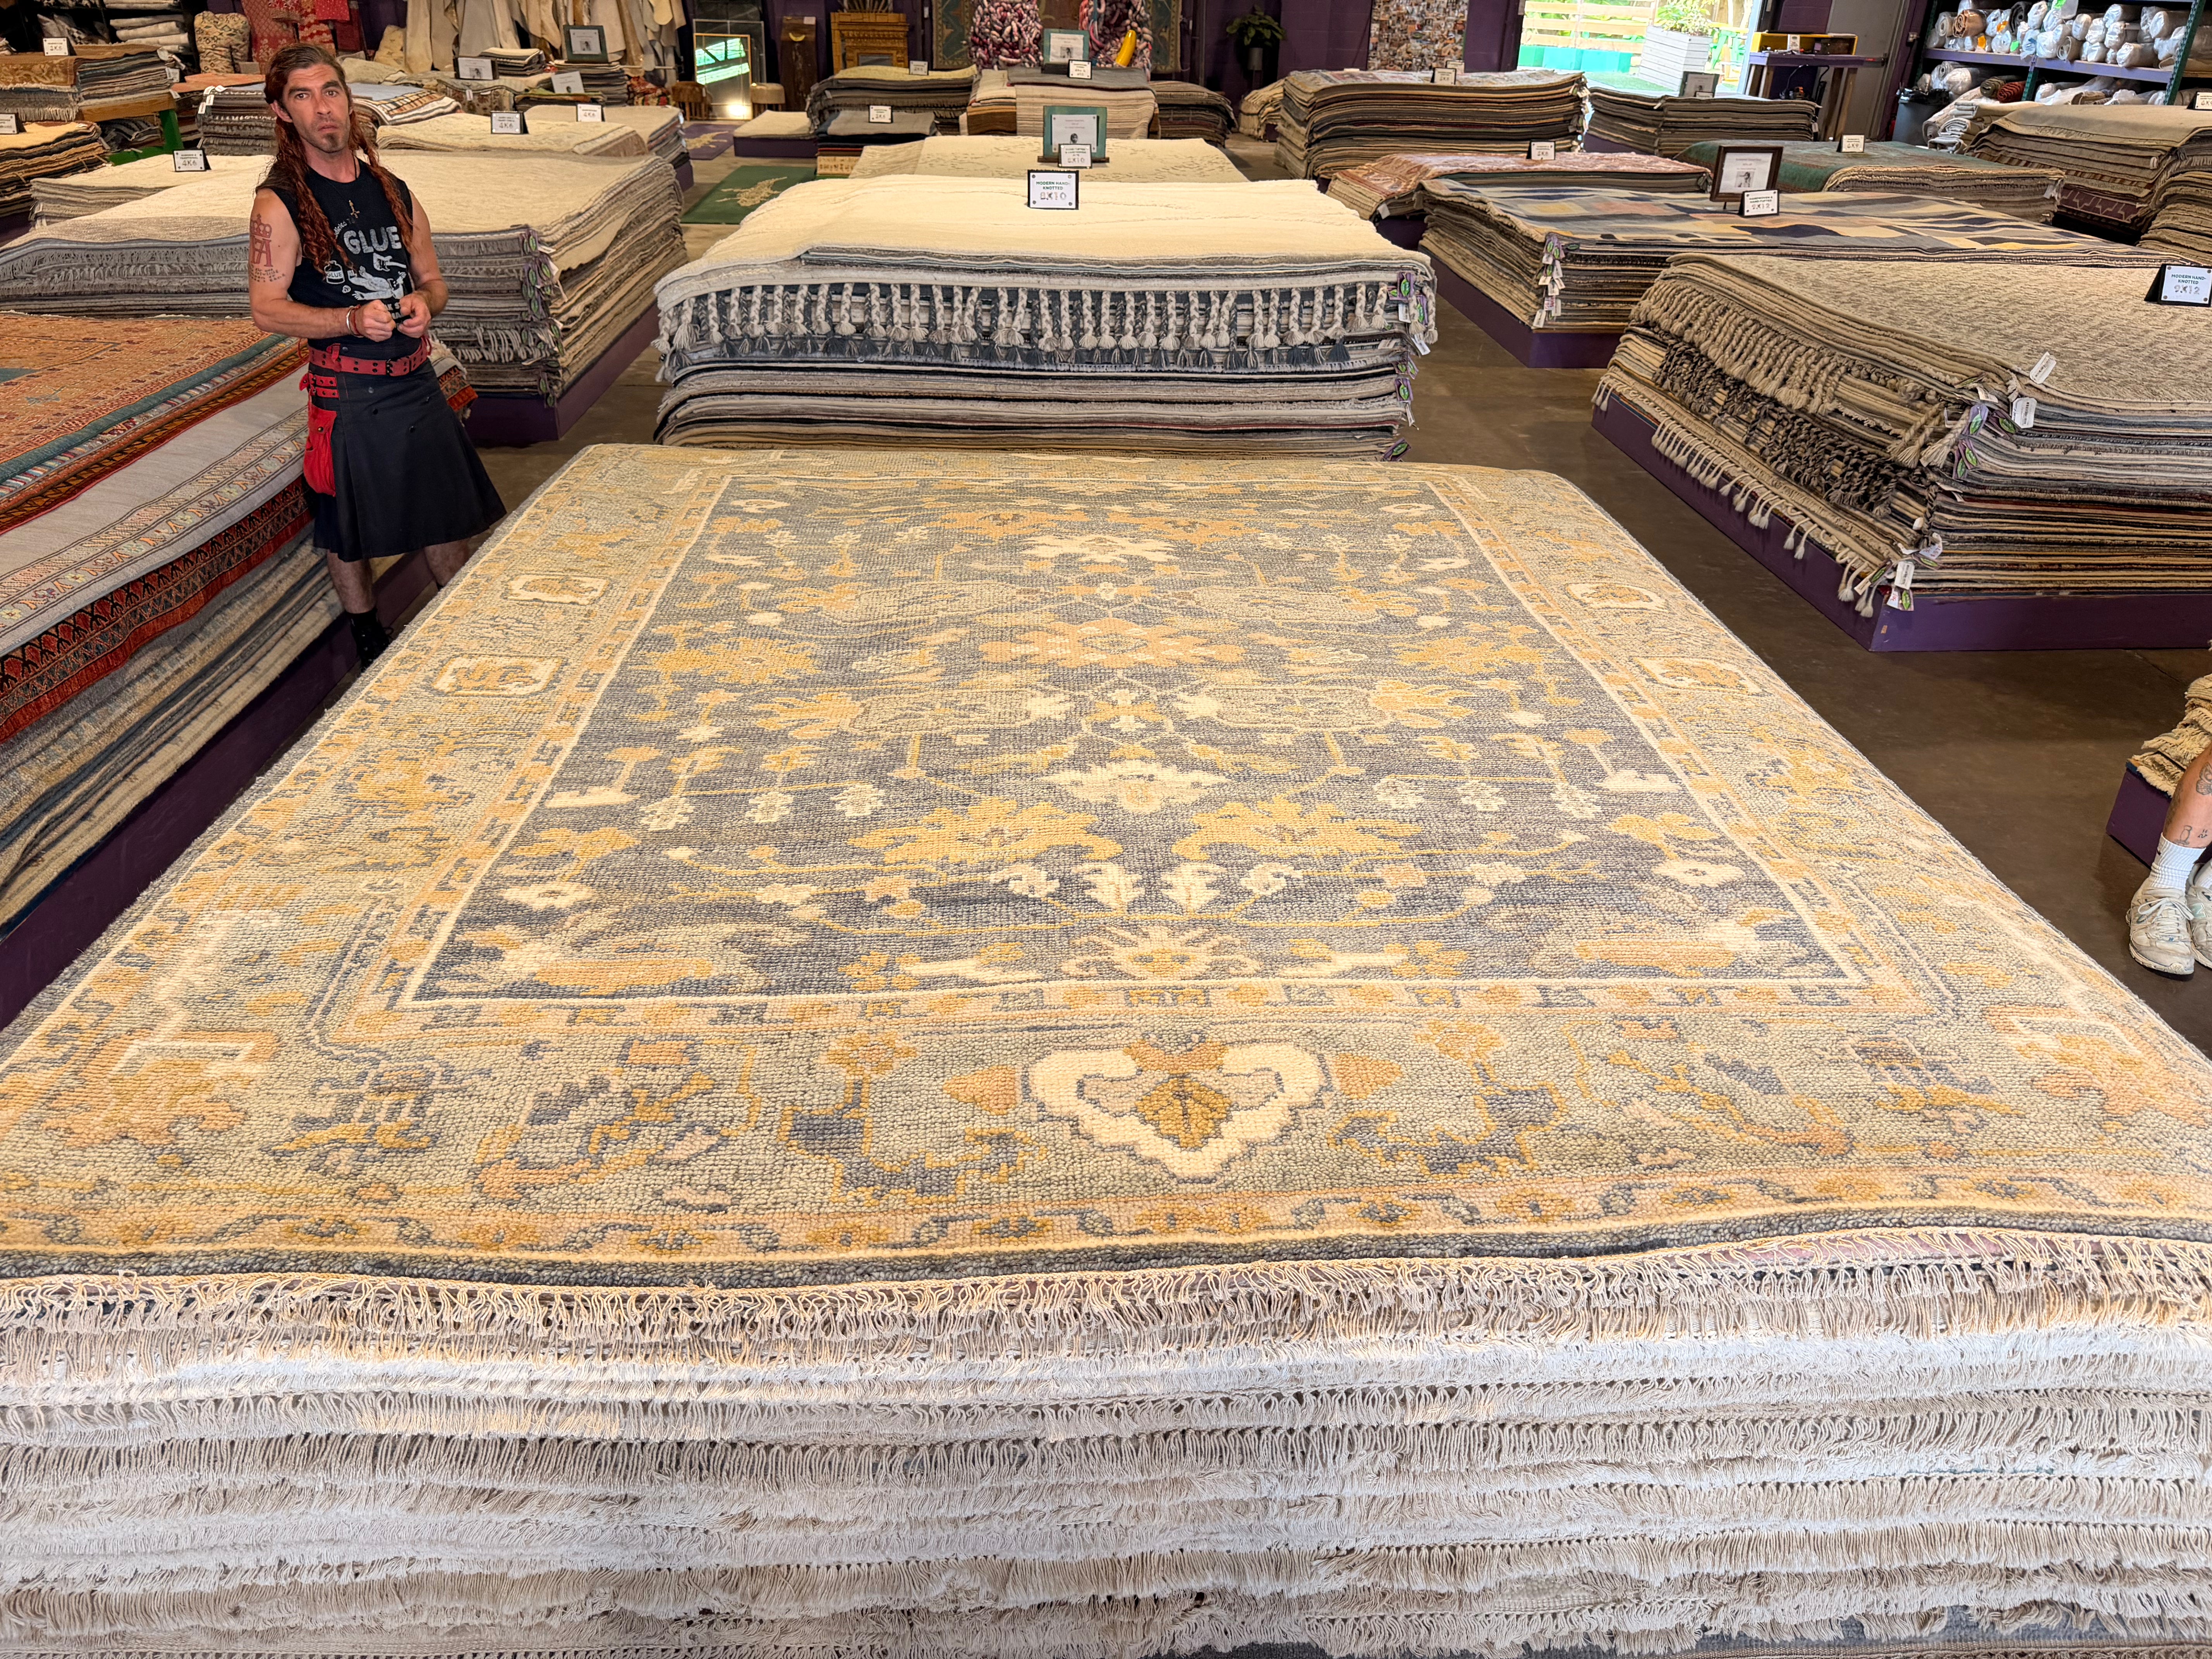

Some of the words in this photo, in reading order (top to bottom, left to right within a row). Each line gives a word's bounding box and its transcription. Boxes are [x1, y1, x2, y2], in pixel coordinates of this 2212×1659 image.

[1040, 192, 1067, 200] 8X10
[343, 226, 402, 254] GLUE
[2174, 285, 2200, 294] 9X12
